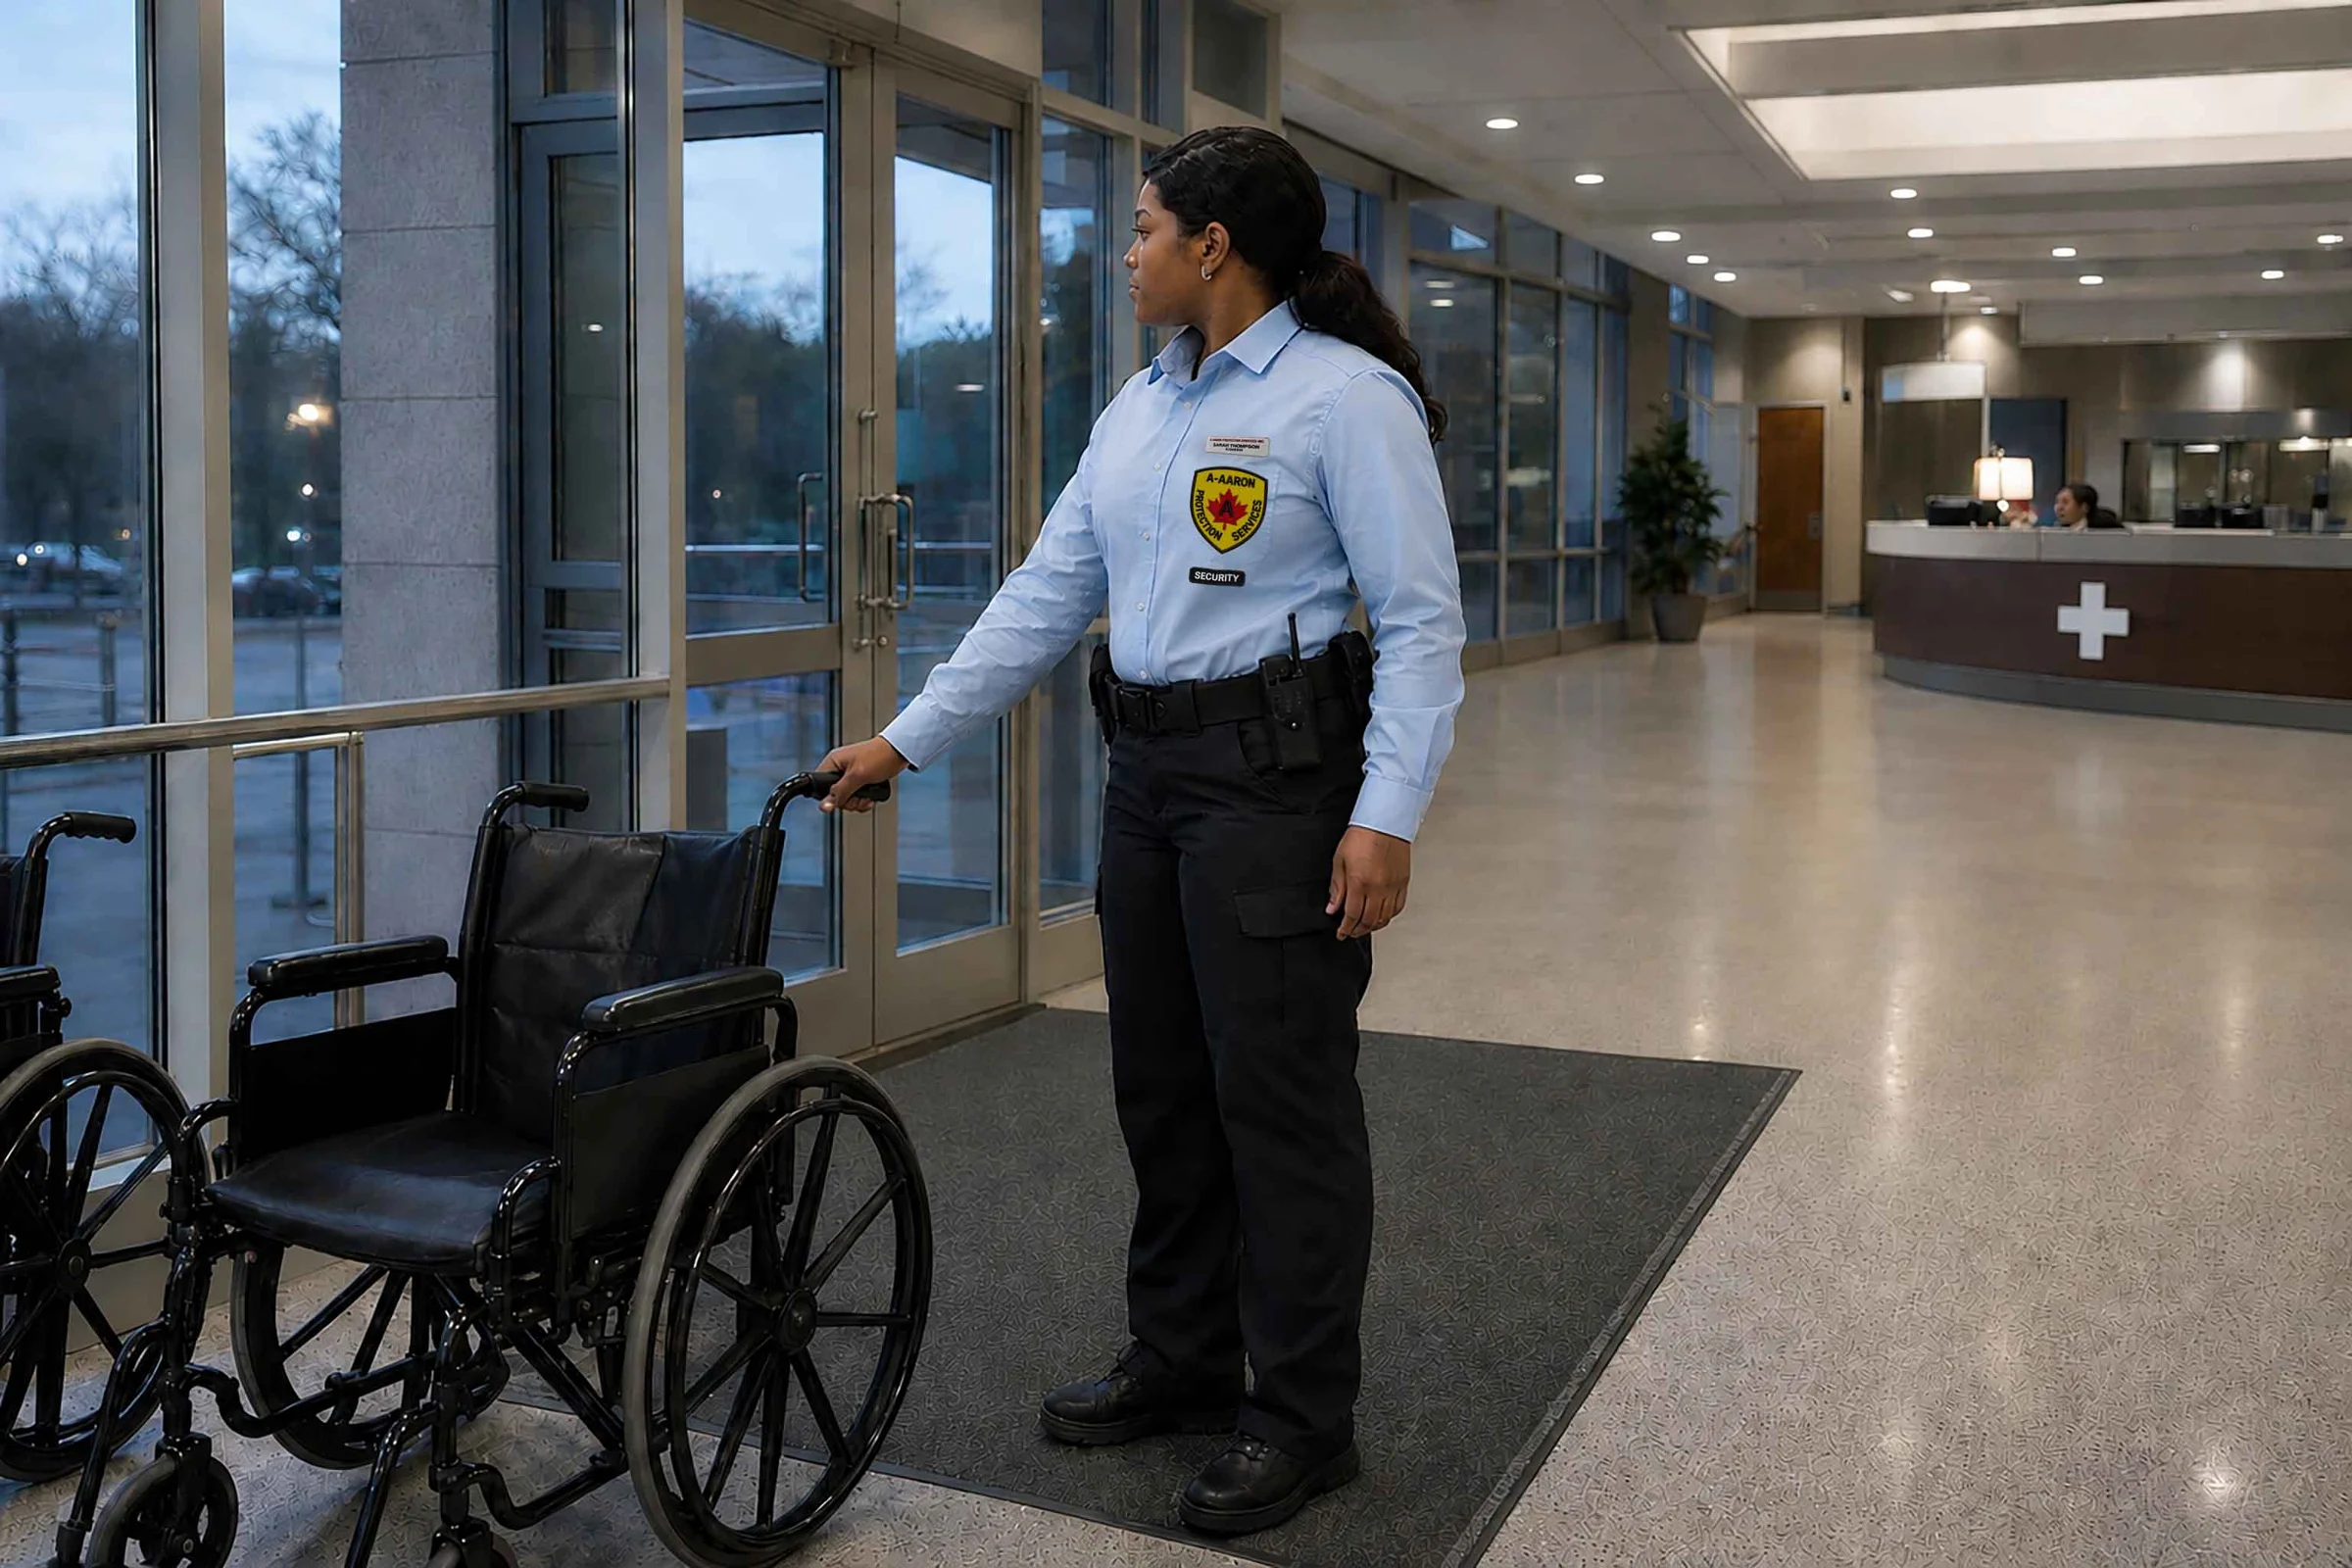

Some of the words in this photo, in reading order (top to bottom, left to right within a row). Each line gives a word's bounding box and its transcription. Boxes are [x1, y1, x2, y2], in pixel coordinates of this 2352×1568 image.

[1206, 472, 1256, 488] A-AARON
[1195, 489, 1223, 541] PROTECTION
[1231, 500, 1262, 541] SERVICES
[1194, 570, 1240, 583] SECURITY
